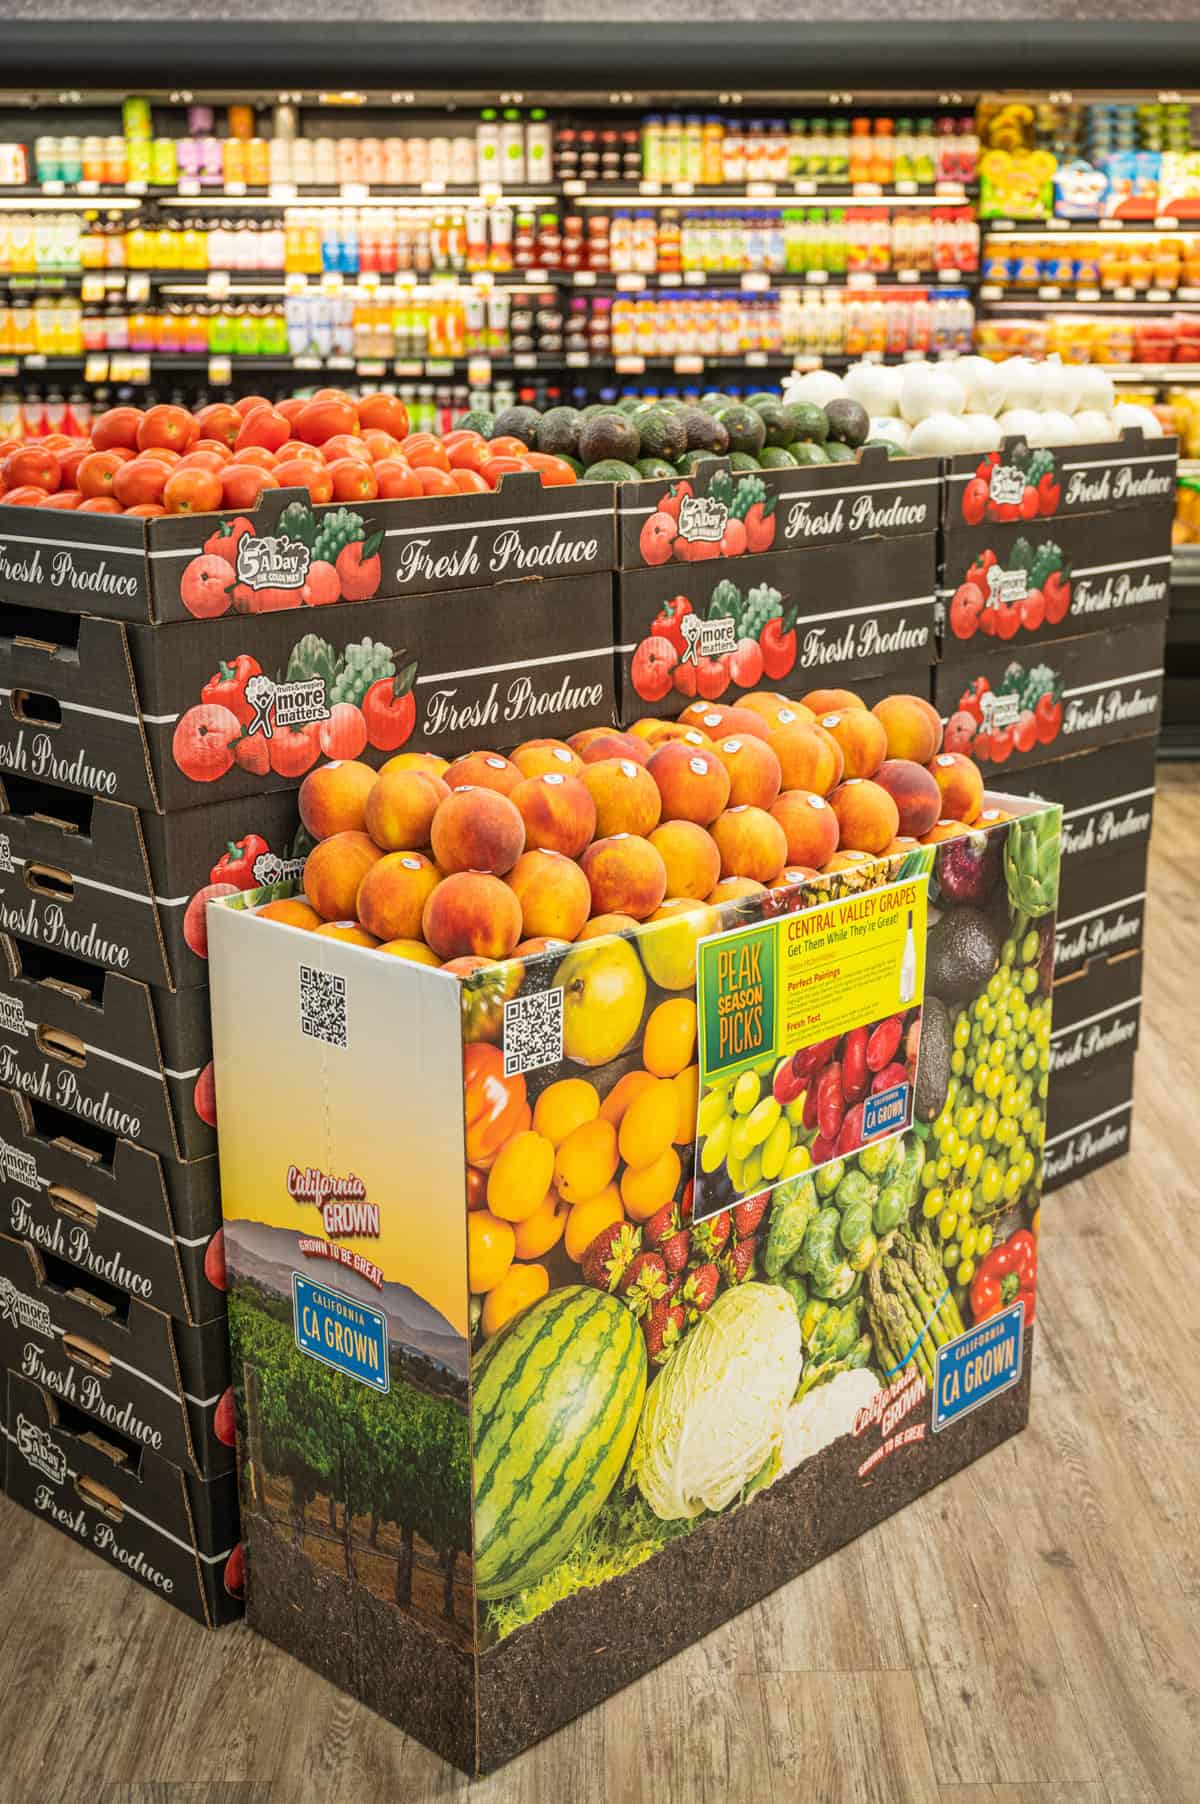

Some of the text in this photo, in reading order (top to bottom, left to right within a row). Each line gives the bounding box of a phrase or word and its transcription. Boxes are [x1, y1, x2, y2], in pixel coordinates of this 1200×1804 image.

[1065, 467, 1171, 504] Fresh Produce
[785, 494, 927, 538] Fresh Produce
[50, 551, 138, 597] Produce
[243, 550, 299, 577] 5 A Day
[396, 529, 598, 583] Fresh Produce
[1072, 574, 1166, 616] Fresh Produce
[703, 627, 733, 643] more
[800, 618, 929, 668] Fresh Produce
[278, 690, 323, 710] more
[278, 707, 324, 723] matters
[424, 675, 603, 736] Fresh Produce
[0, 730, 118, 794] esh Produce
[0, 888, 129, 968] resh Produce
[788, 886, 916, 941] CENTRAL VALLEY GRAPES
[788, 944, 802, 957] Get
[804, 938, 825, 952] Them
[827, 930, 847, 945] While
[718, 941, 762, 994] PEAK
[718, 983, 763, 1015] SEASON
[719, 1006, 763, 1059] PICKS
[0, 1045, 141, 1138] Fresh Produce
[7, 1154, 36, 1177] more
[287, 1165, 365, 1206] California
[323, 1203, 380, 1238] GROWN
[10, 1197, 153, 1298] Fresh Produce
[298, 1239, 328, 1256] GROWN
[329, 1243, 340, 1259] TO
[341, 1248, 353, 1266] BE
[20, 1302, 49, 1326] more
[312, 1291, 365, 1325] CALIFORNIA
[303, 1306, 379, 1370] CA GROWN
[955, 1323, 1005, 1360] CALIFORNIA
[942, 1336, 1015, 1406] CA GROWN
[22, 1342, 163, 1450] Fresh Produce
[882, 1374, 926, 1437] GROWN
[21, 1430, 32, 1453] 5
[33, 1439, 40, 1457] A
[34, 1485, 174, 1593] Fresh Produce
